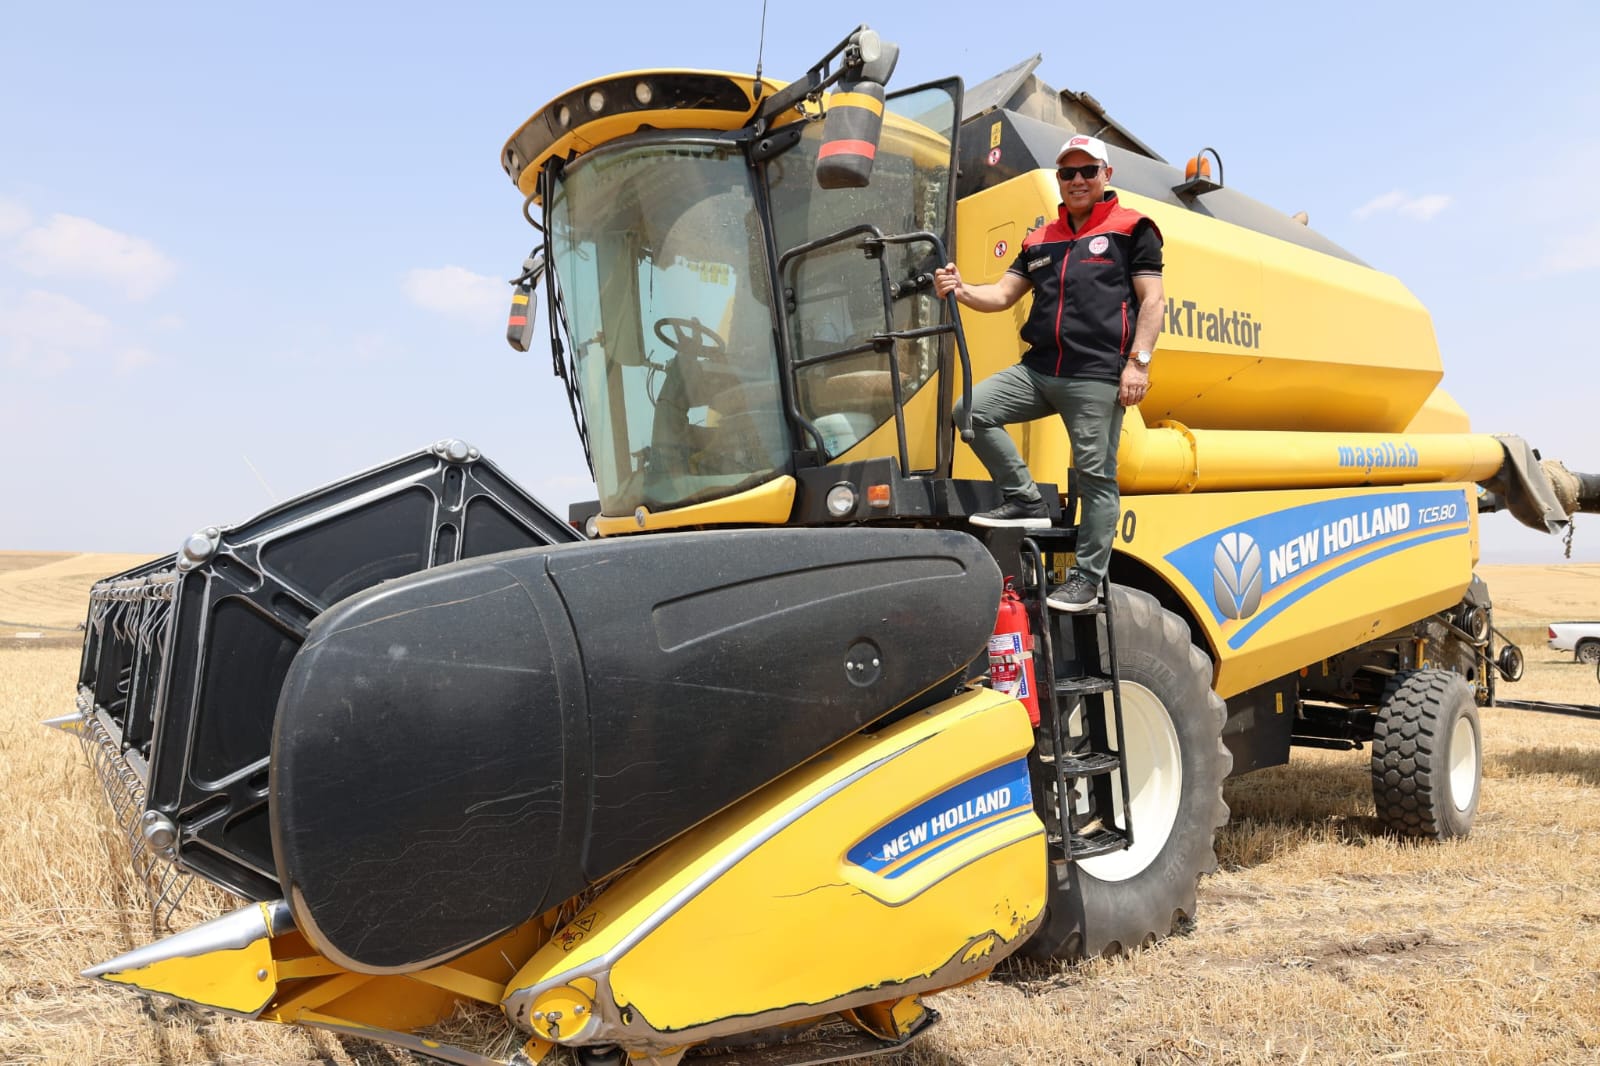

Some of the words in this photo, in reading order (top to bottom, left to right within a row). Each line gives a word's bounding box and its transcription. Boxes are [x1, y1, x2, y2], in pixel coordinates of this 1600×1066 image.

[1115, 510, 1136, 543] 0
[1269, 529, 1319, 584] NEW
[1323, 502, 1410, 557] HOLLAND
[882, 822, 928, 861] NEW
[931, 787, 1011, 836] HOLLAND
